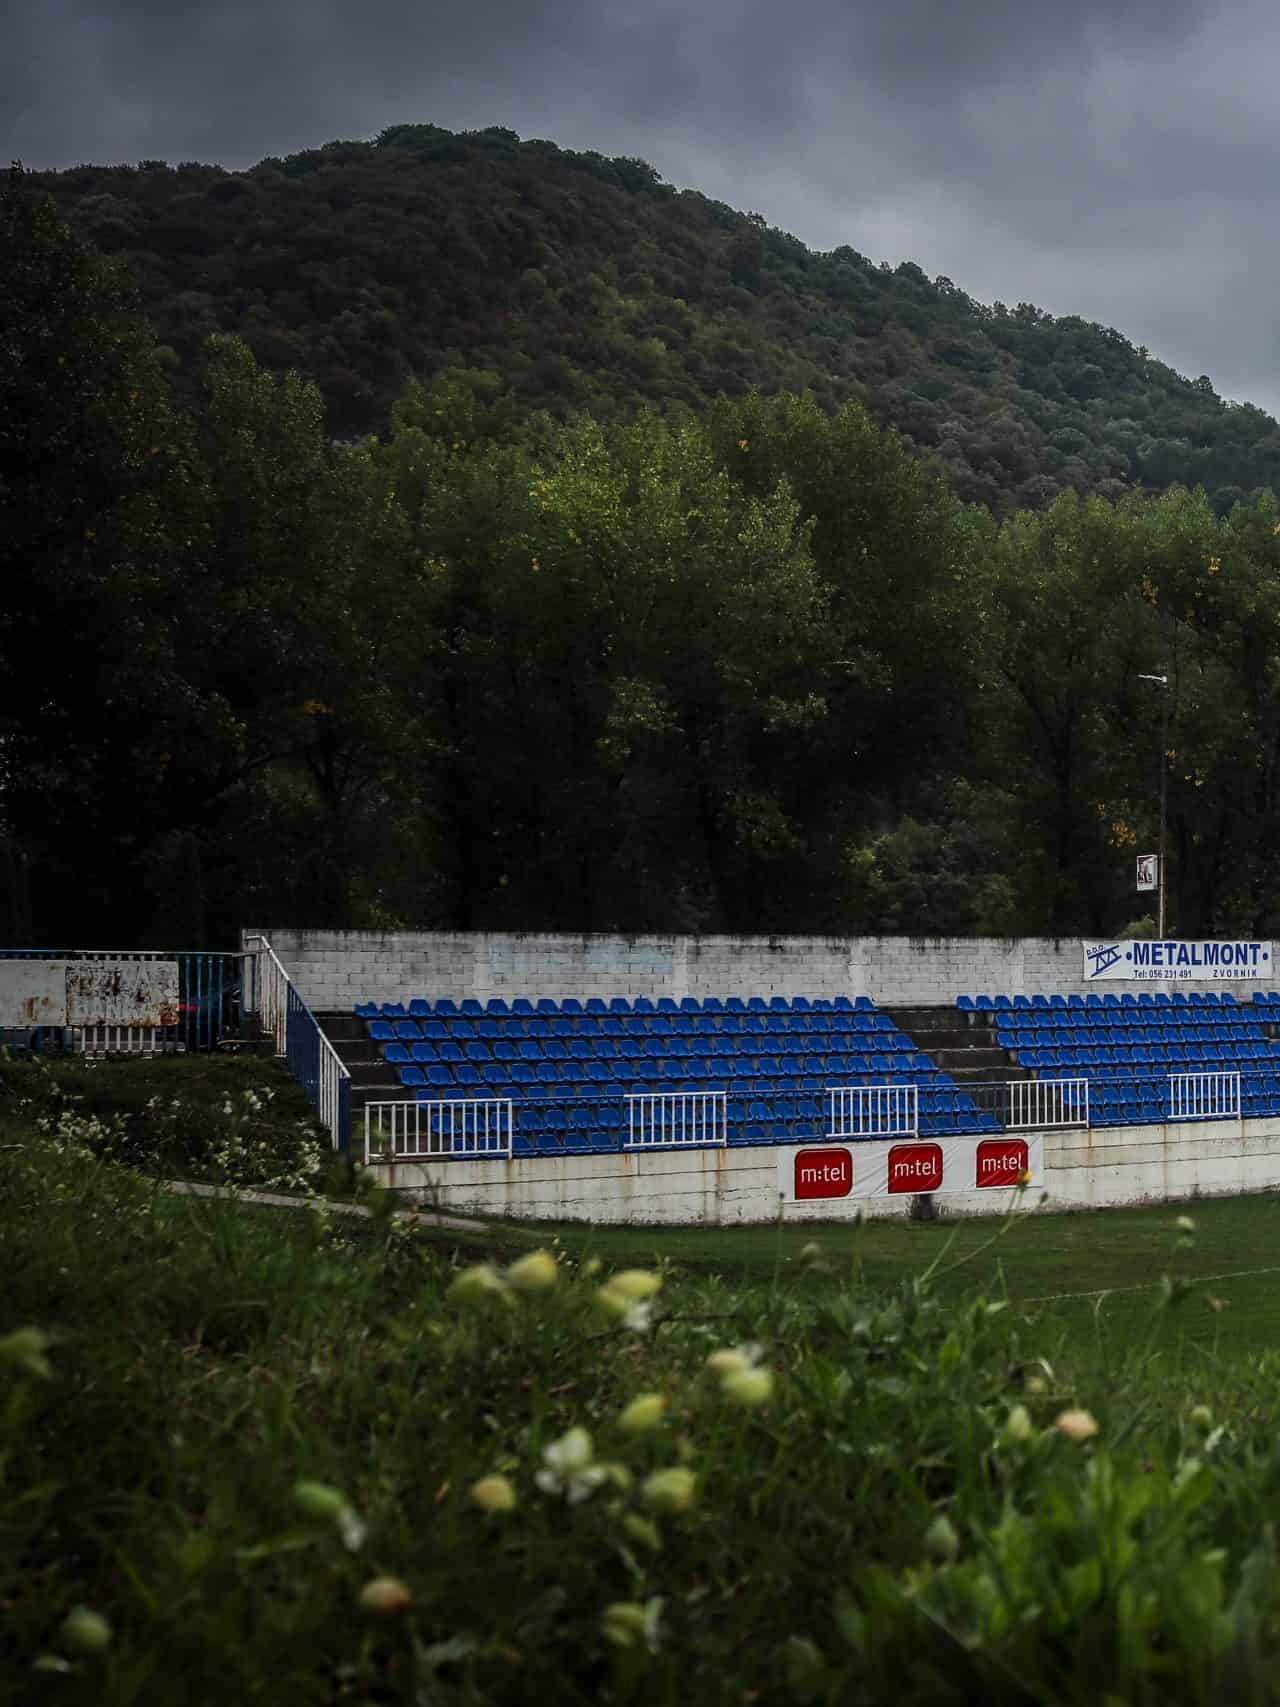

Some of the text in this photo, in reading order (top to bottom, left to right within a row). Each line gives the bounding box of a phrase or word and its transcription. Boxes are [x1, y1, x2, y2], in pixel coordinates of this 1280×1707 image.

[1133, 943, 1261, 966] METALMONT
[1149, 969, 1163, 978] 056
[1212, 969, 1257, 978] ZVORNIK
[801, 1162, 846, 1183] m:tel
[894, 1157, 936, 1178] m:tel
[982, 1152, 1022, 1173] m:tel
